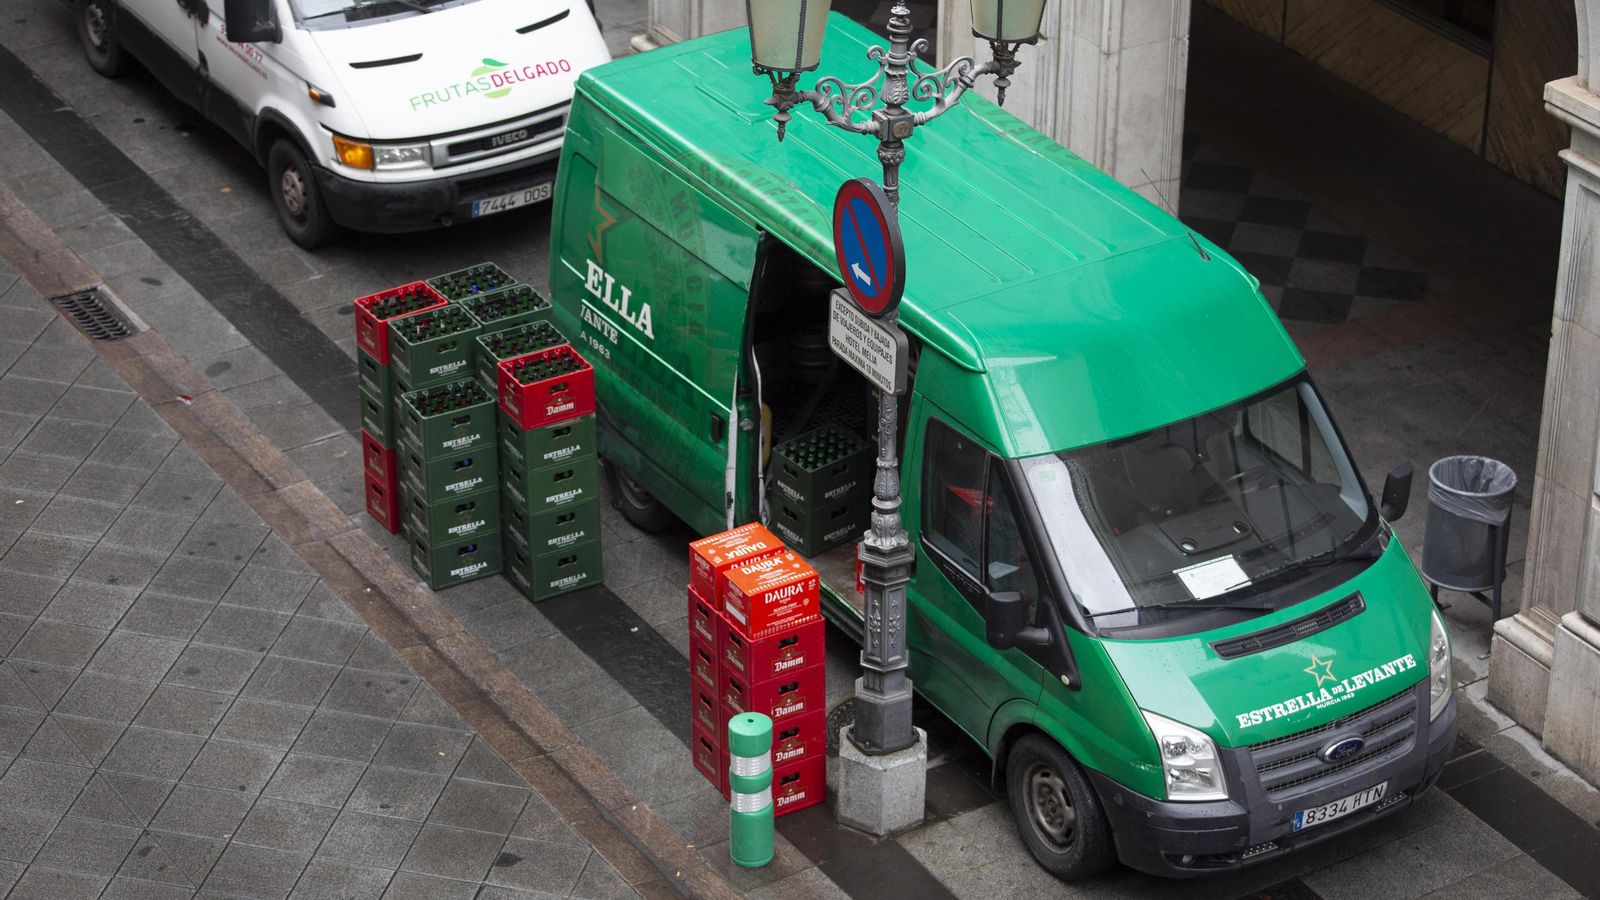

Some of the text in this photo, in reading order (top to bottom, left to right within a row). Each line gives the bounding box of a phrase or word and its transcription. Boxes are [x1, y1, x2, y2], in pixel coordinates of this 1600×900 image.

[492, 129, 528, 147] IVECO
[482, 196, 516, 214] 7444
[584, 258, 655, 340] ELLA
[836, 300, 855, 321] EXCEPTO
[874, 330, 890, 350] BAJADA
[832, 310, 893, 365] DE VIAJEROS Y EQUIPAJES
[845, 333, 861, 354] HOTEL
[589, 336, 611, 359] 1963
[831, 335, 848, 354] PARADA
[866, 363, 872, 375] 10
[546, 402, 574, 416] Damm
[443, 433, 481, 448] ESTRELLA
[543, 444, 581, 460] ESTRELLA
[445, 476, 483, 492] ESTRELLA
[545, 487, 583, 503] ESTRELLA
[448, 519, 486, 535] ESTRELLA
[548, 530, 585, 546] ESTRELLA
[725, 541, 767, 560] DAURA
[451, 561, 488, 577] ESTRELLA
[741, 557, 784, 575] DAURA
[550, 572, 588, 588] ESTRELLA
[765, 583, 804, 604] DAURA
[774, 655, 804, 672] Damm
[1235, 653, 1417, 729] ESTRELLA DE LEVANTE
[774, 702, 804, 718] Damm
[1316, 692, 1355, 710] MURCIA 1963
[776, 746, 805, 762] Damm
[777, 790, 805, 807] Damm
[1306, 784, 1384, 824] 8334 HTN
